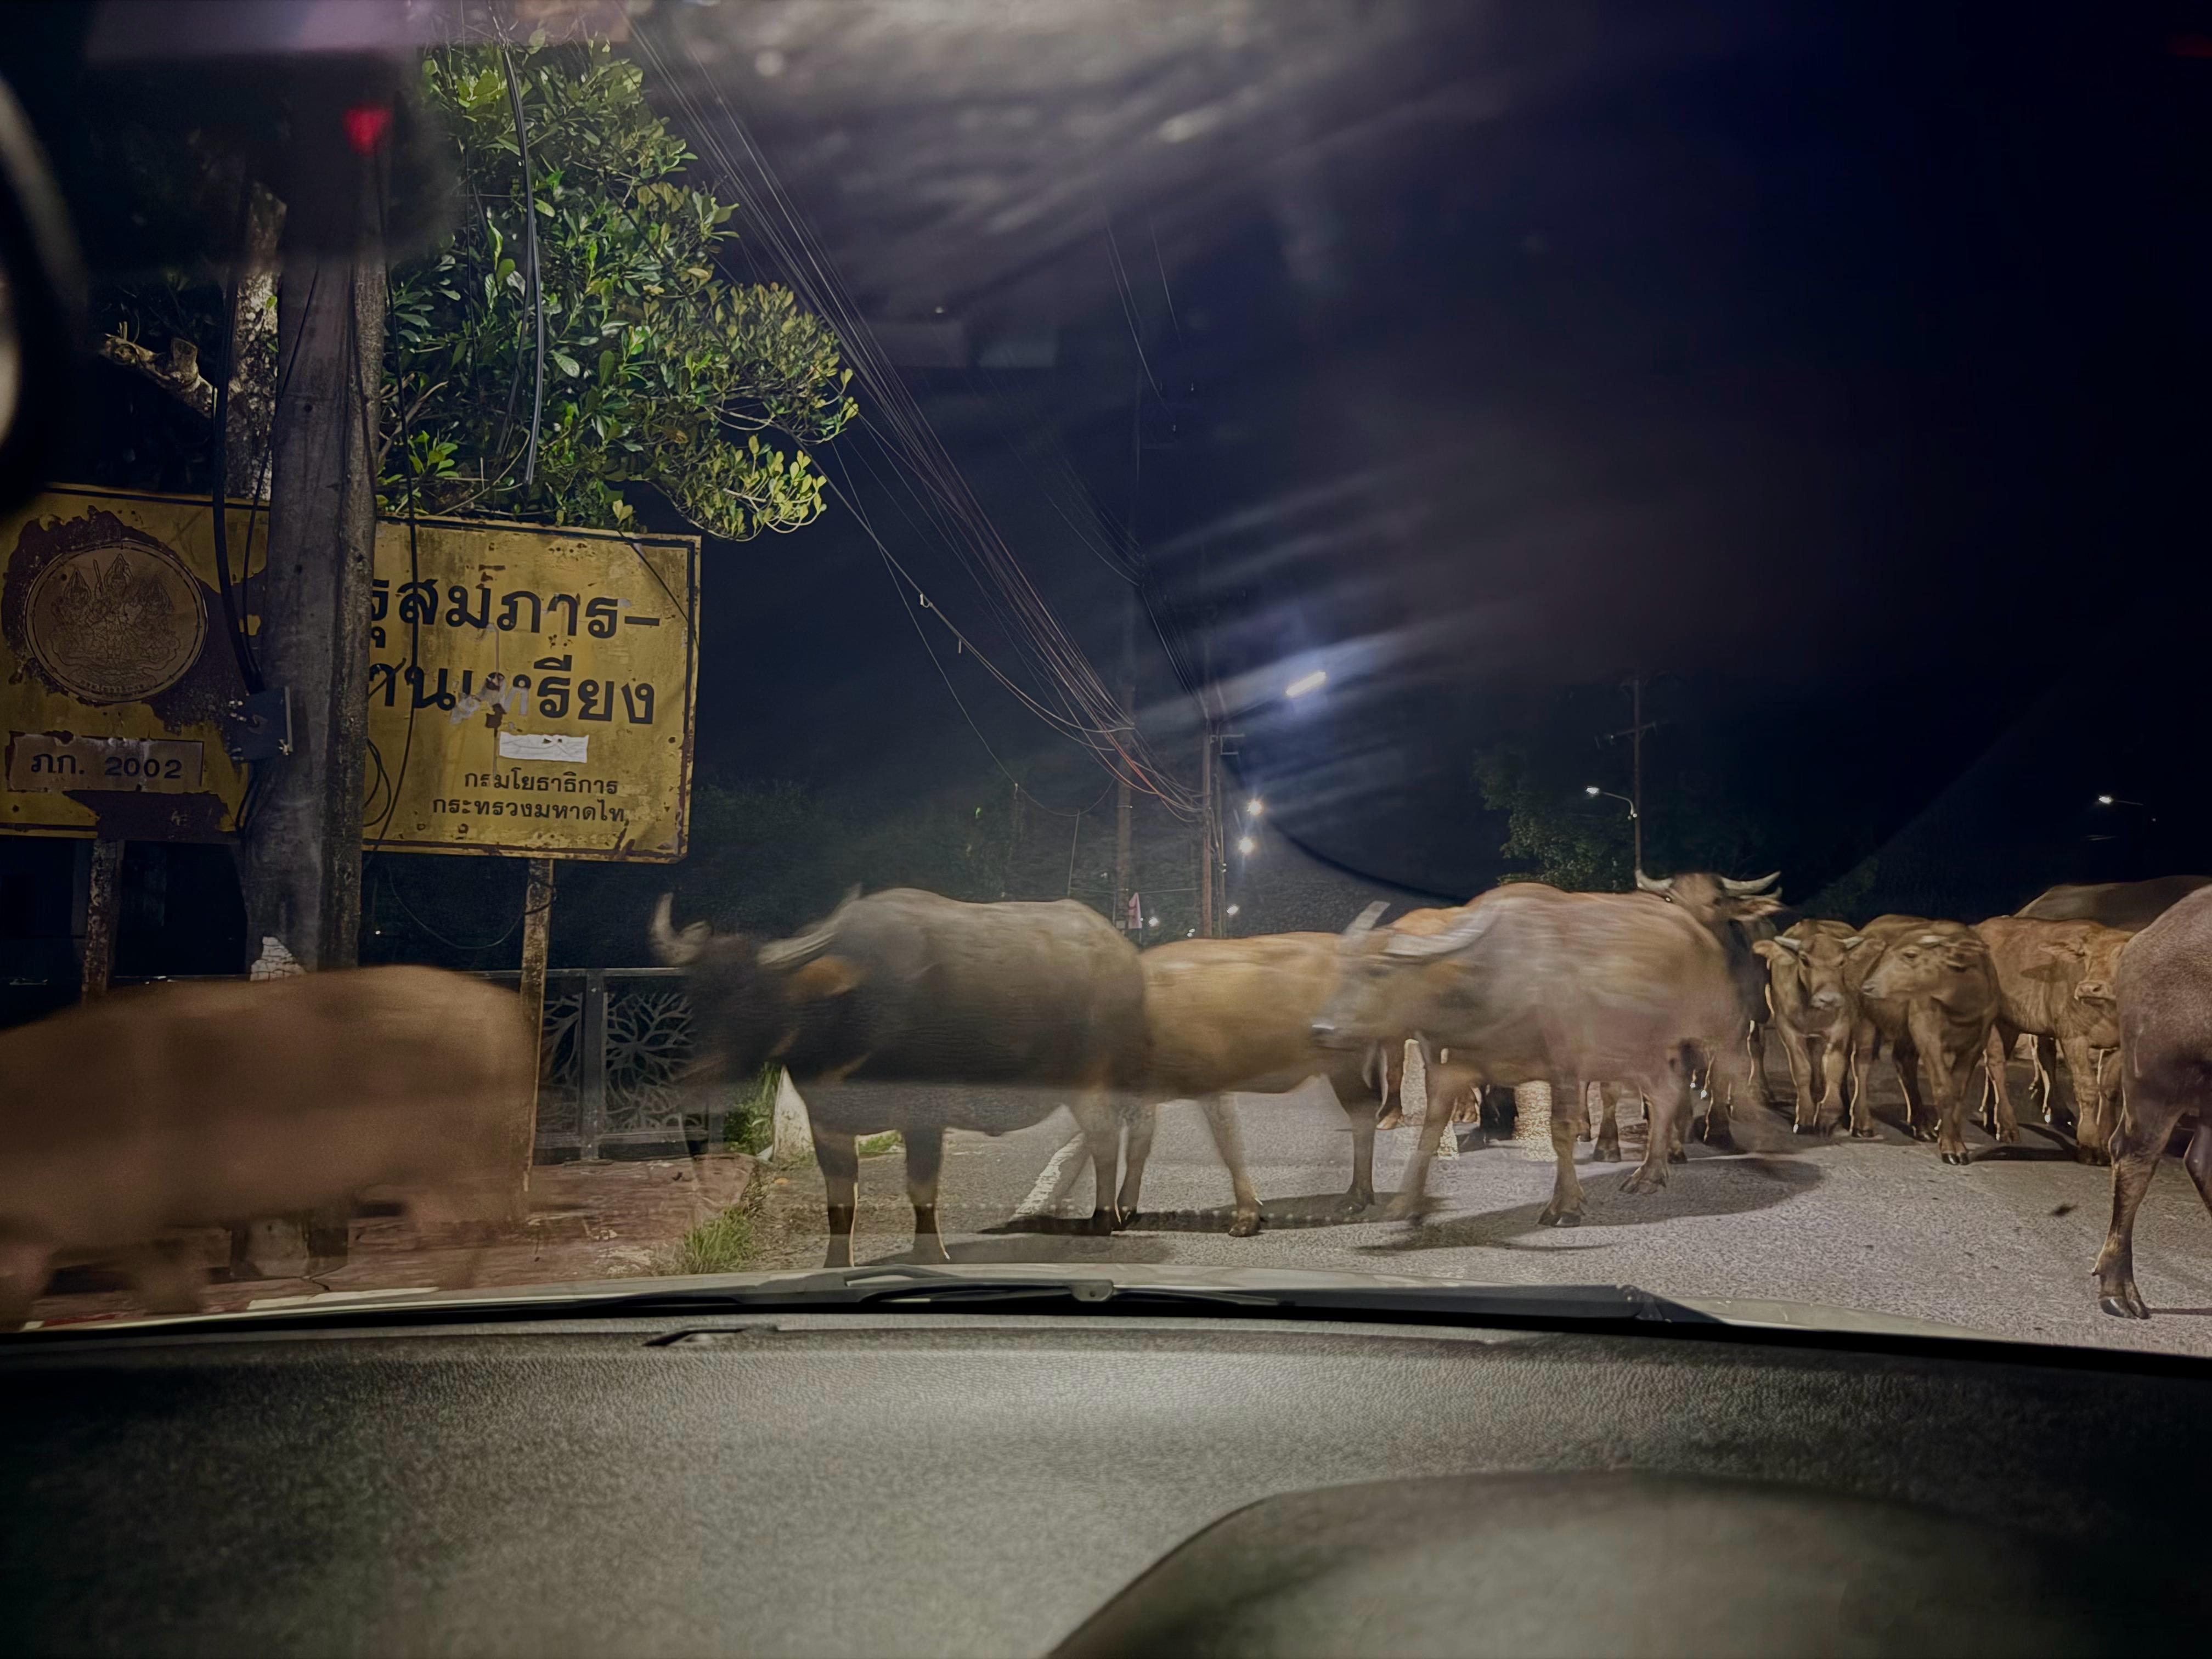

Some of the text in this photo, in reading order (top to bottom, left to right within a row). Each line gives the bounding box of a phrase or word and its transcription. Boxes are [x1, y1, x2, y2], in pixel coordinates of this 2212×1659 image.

[31, 753, 182, 779] ภก. 2002
[464, 768, 618, 794] กรมโยธาธิการ
[433, 799, 631, 822] กระทรวงมหาดไท
